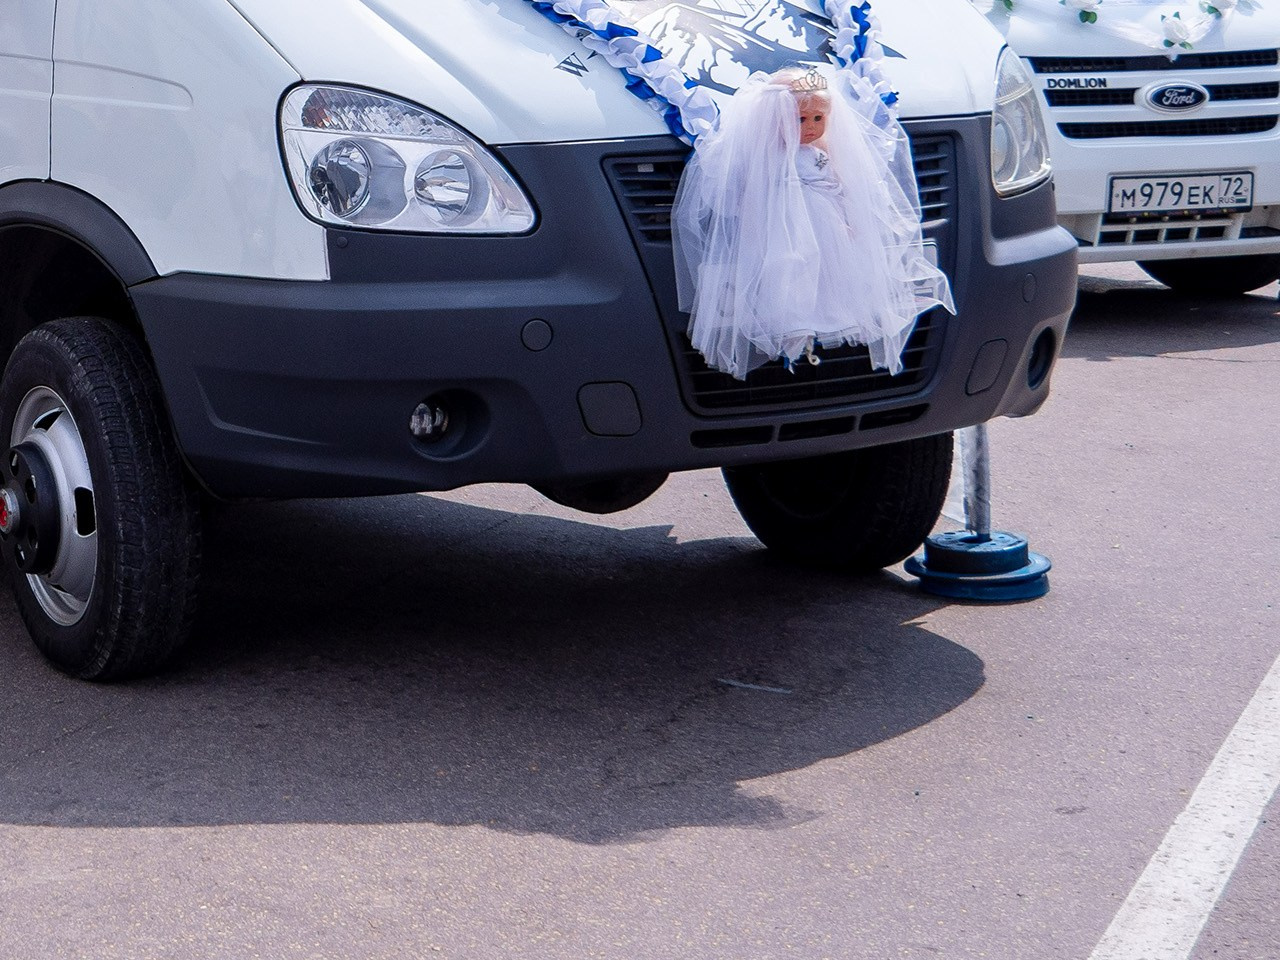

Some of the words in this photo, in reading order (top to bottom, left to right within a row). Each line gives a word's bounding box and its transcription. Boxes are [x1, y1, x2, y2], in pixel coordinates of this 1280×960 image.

[553, 51, 589, 77] W
[1047, 77, 1107, 89] DOMLION
[1161, 88, 1196, 107] Ford
[1222, 176, 1244, 197] 72
[1219, 196, 1235, 205] RUS
